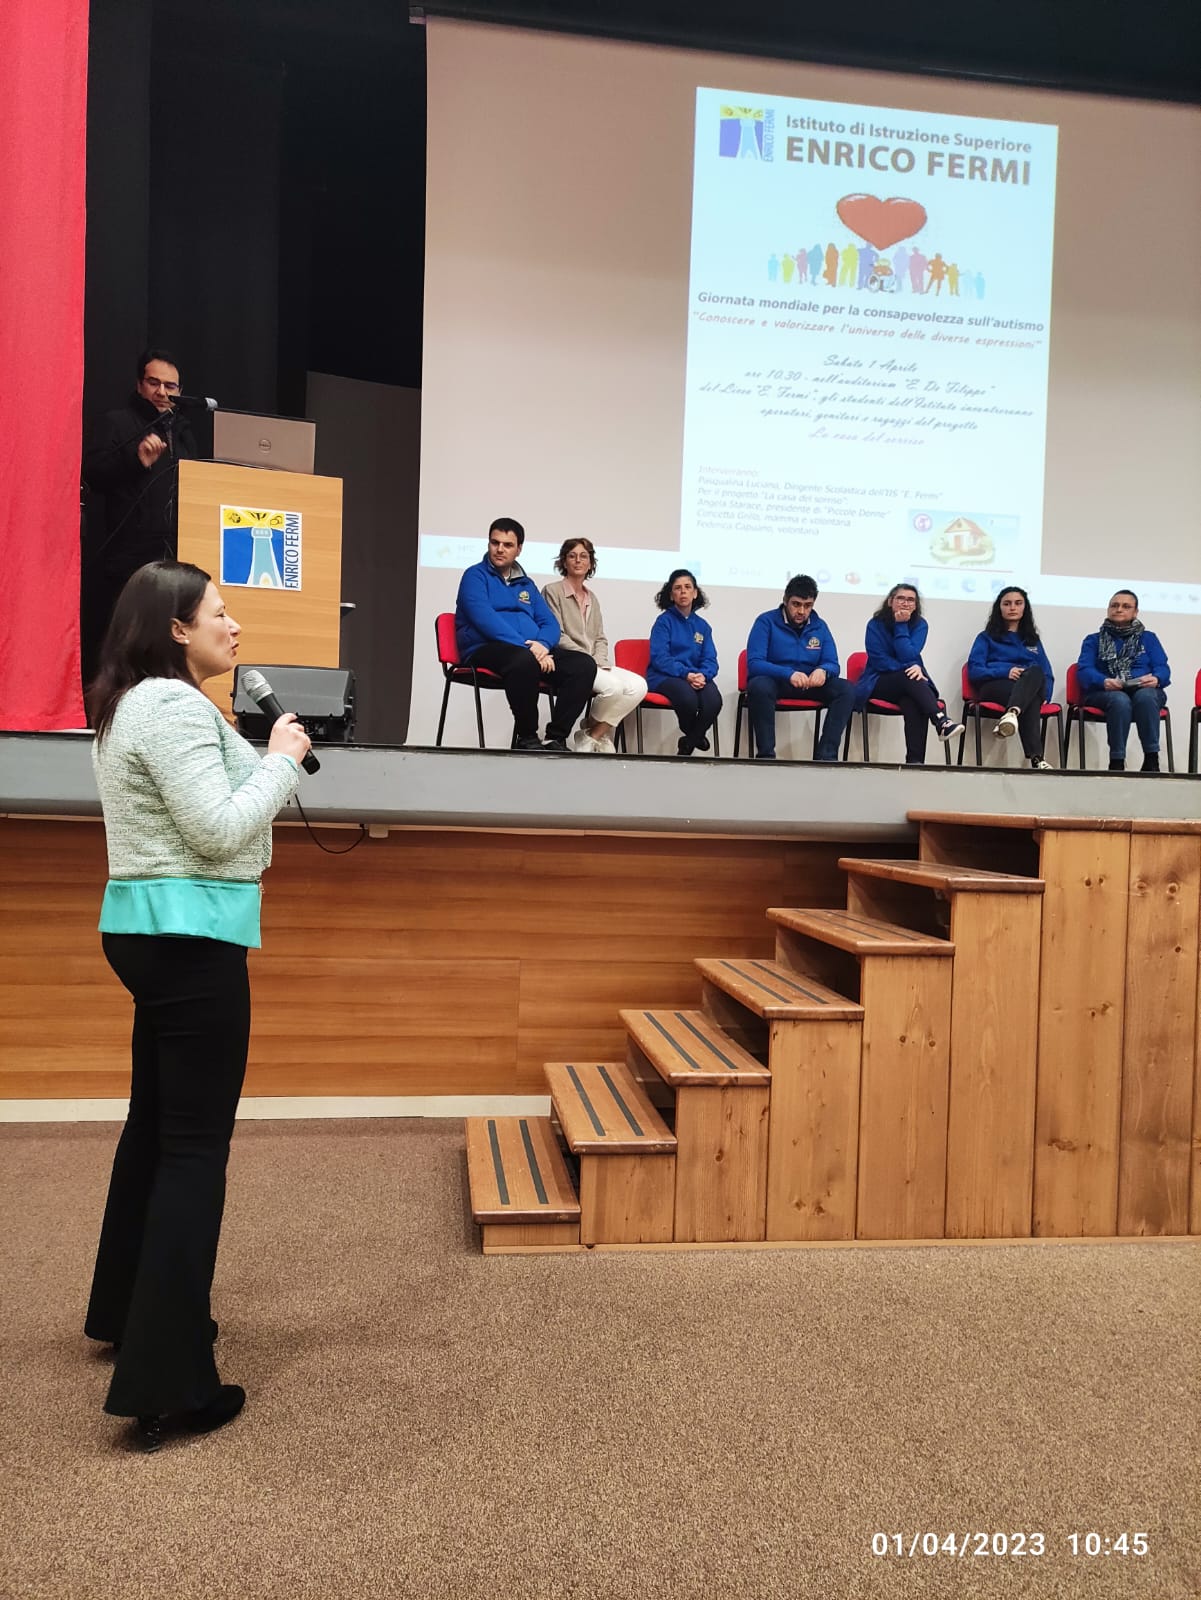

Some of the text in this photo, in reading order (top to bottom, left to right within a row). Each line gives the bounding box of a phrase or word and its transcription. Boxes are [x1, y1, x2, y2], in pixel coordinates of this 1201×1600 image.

[787, 115, 1032, 153] Istituto di Istruzione Superiore
[786, 135, 1031, 185] ENRICO FERMI
[693, 311, 755, 326] "Conoscere
[761, 319, 769, 328] e
[774, 320, 834, 333] valorizzare
[840, 323, 895, 338] l'universo
[900, 329, 926, 341] delle
[931, 331, 970, 345] diverse
[698, 291, 1045, 332] Giornata mondiale per la consapevolezza sull'autismo
[824, 353, 918, 373] Sabato 1 Aprile
[699, 381, 721, 392] del
[720, 383, 752, 394] Liceo
[840, 394, 884, 405] studenti
[744, 370, 762, 378] ore
[766, 369, 802, 381] 10.30
[924, 380, 941, 392] De
[932, 421, 979, 433] progetto
[285, 513, 300, 588] ENRICO FERMI
